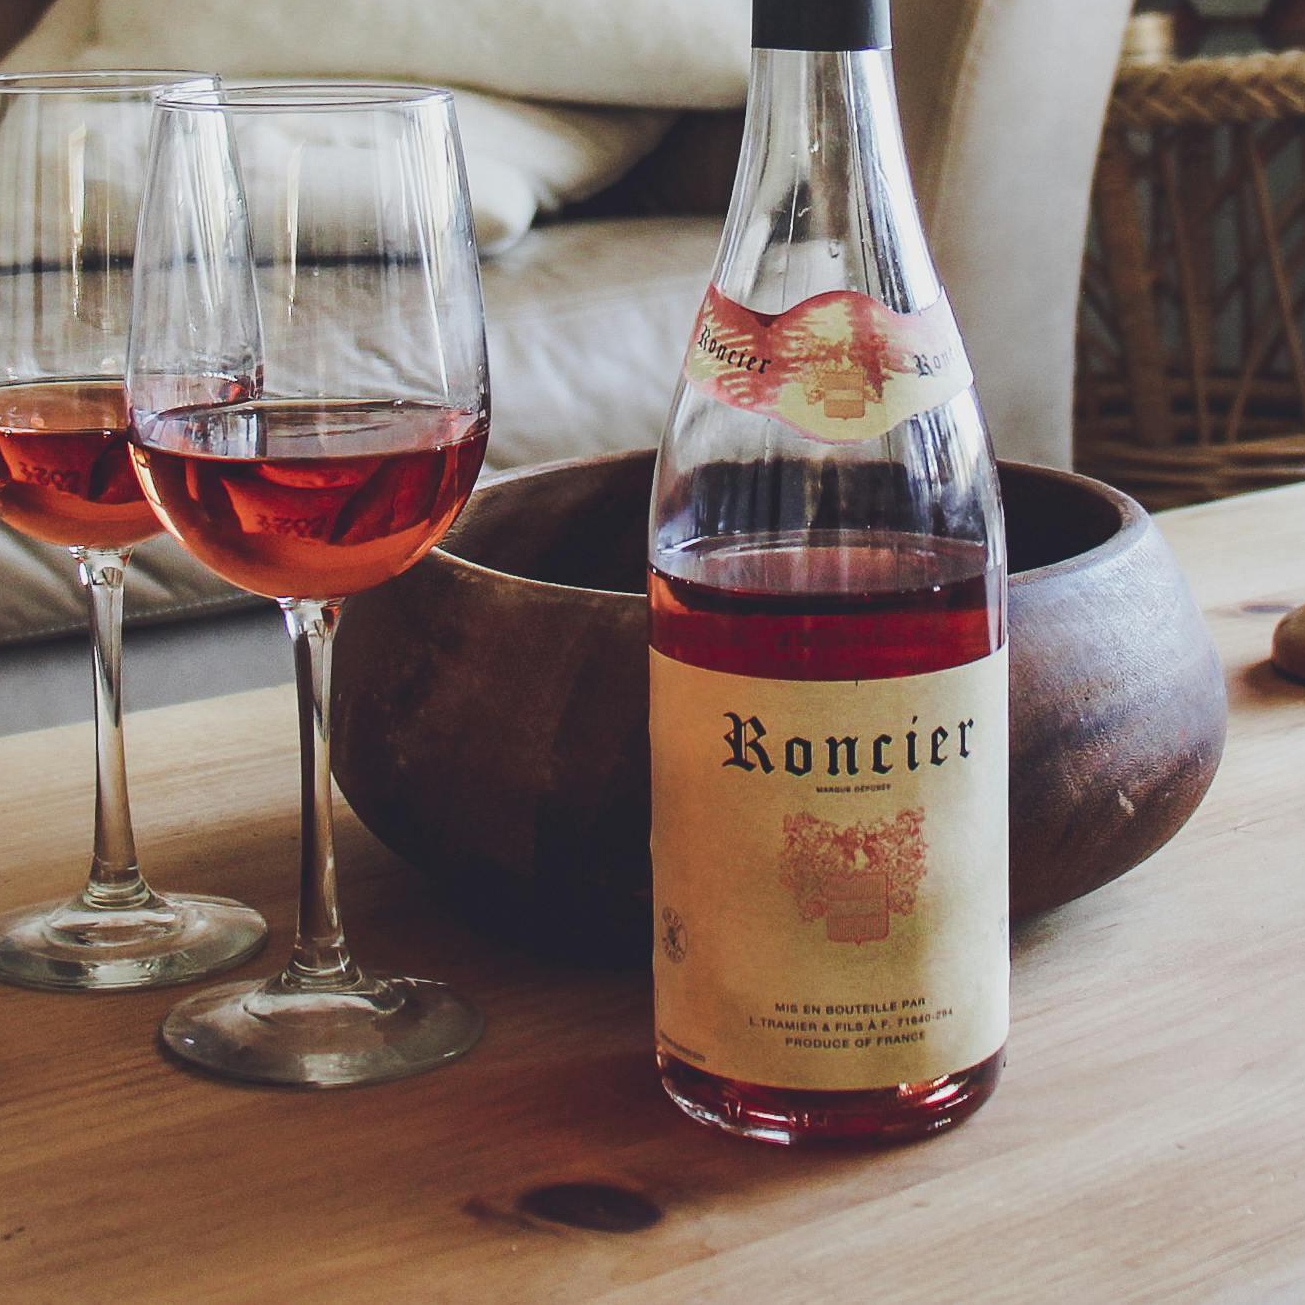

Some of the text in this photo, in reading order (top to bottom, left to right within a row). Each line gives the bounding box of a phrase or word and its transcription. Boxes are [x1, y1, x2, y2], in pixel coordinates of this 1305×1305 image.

[697, 324, 772, 374] Roncier
[722, 711, 974, 777] Roncier
[775, 997, 926, 1015] MIS EN BOUTEILLE PAR
[822, 1023, 830, 1032] &
[835, 1022, 863, 1032] FILS
[785, 1031, 925, 1049] PRODUCE OF FRANCE
